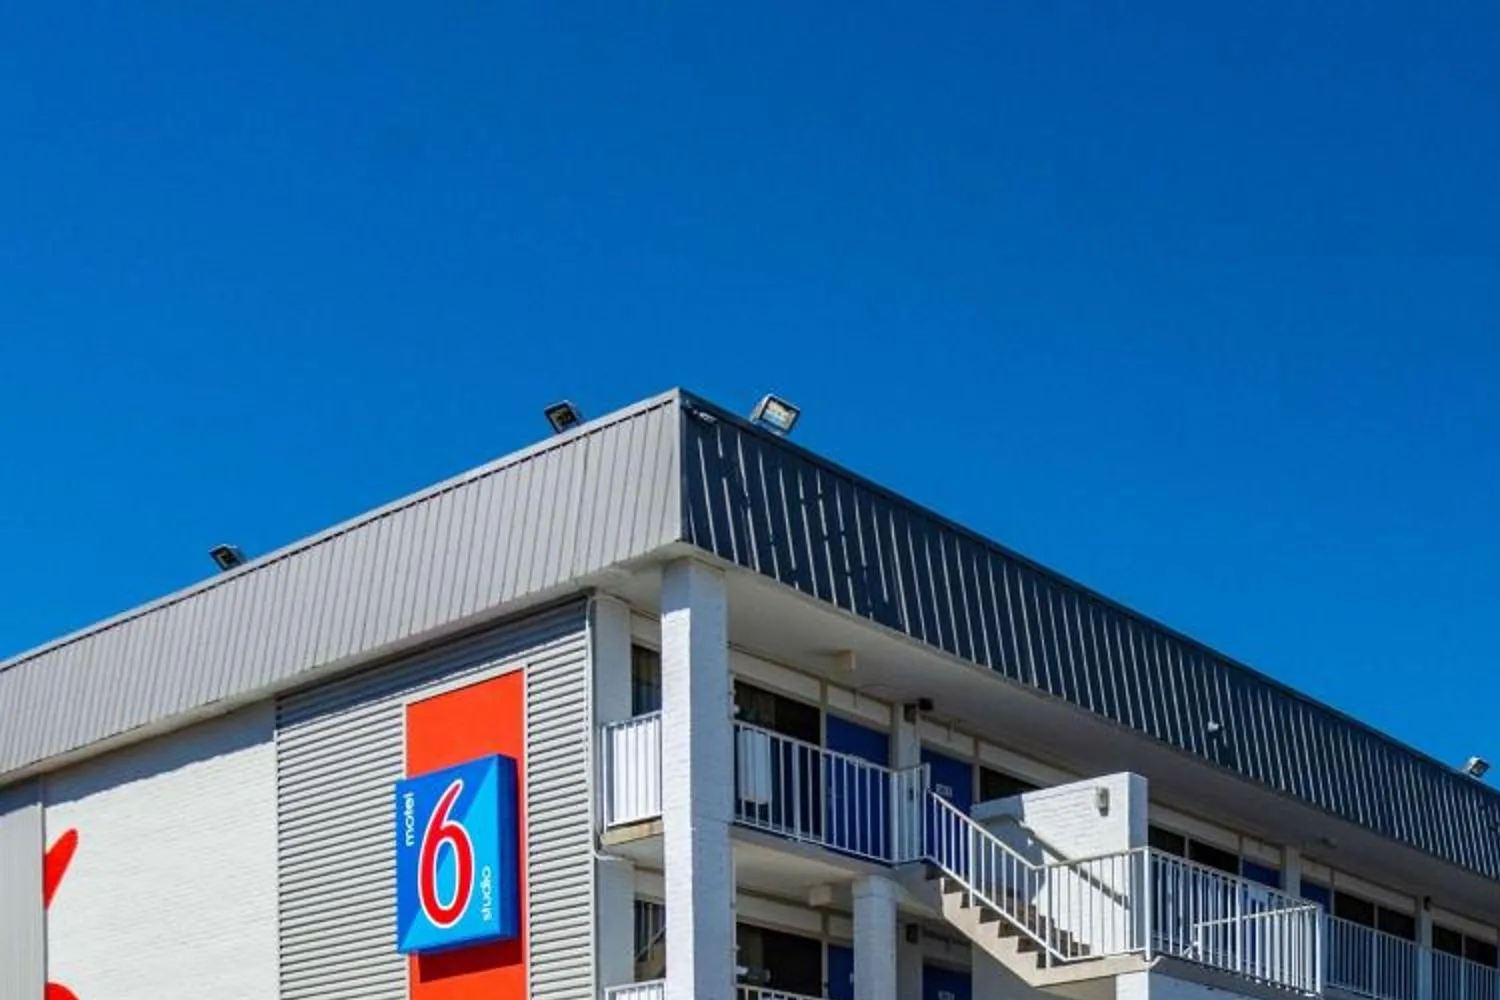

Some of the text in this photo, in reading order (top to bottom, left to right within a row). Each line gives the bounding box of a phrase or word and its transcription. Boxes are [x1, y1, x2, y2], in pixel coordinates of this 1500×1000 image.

[403, 792, 415, 847] motel
[417, 778, 475, 929] 6
[480, 865, 493, 921] studio
